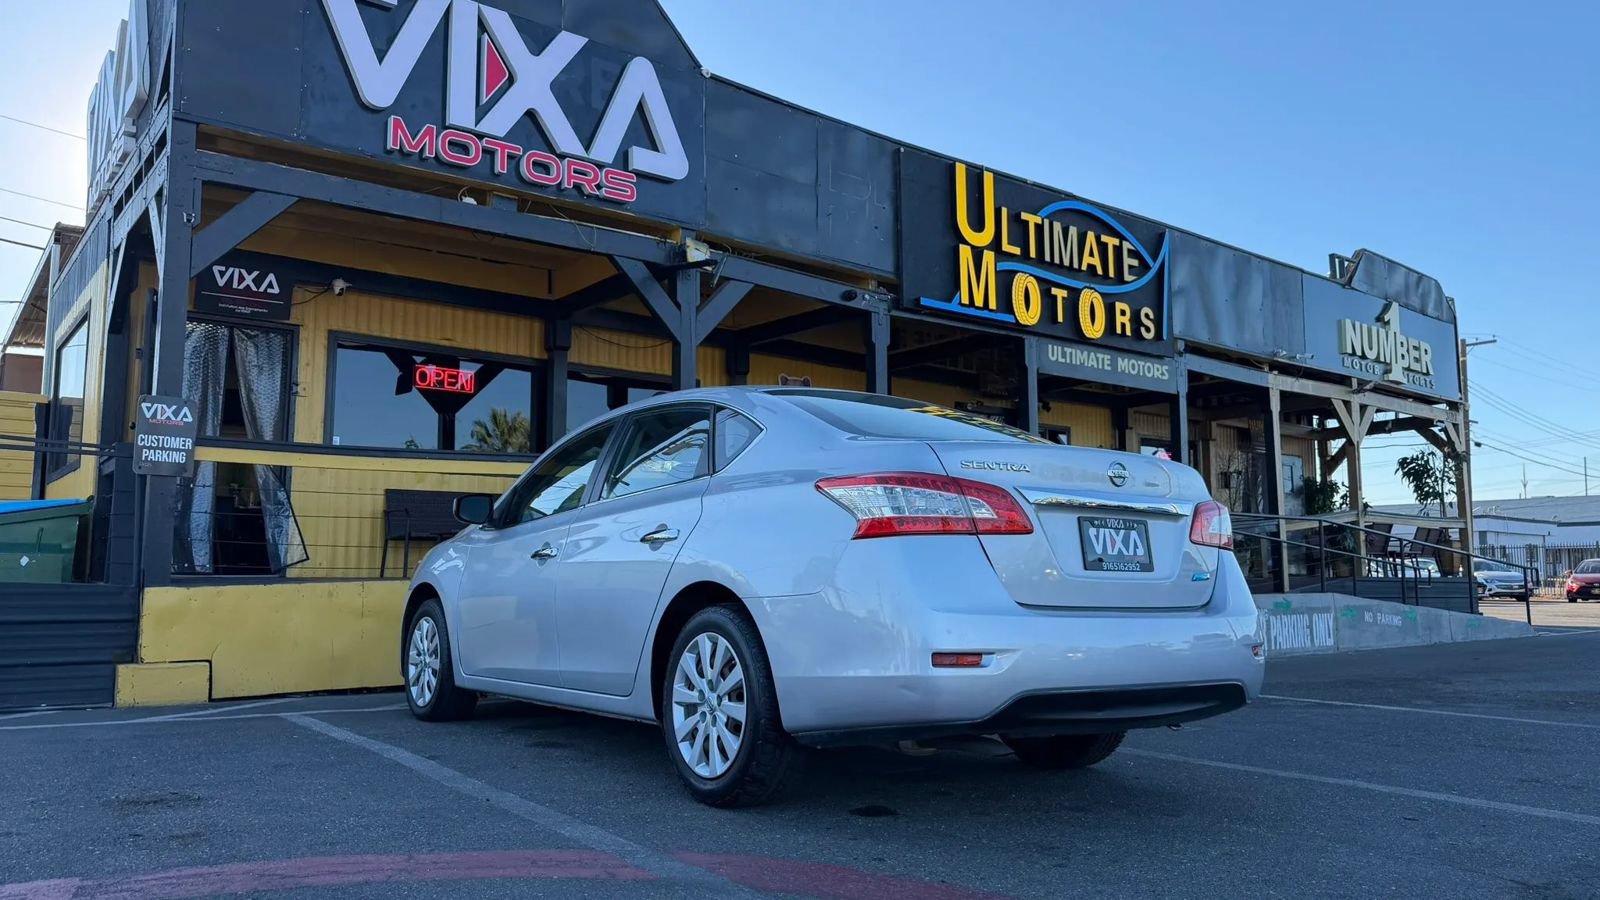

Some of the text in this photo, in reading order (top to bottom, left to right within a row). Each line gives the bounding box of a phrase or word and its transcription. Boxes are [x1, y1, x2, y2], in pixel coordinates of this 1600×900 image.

[322, 0, 690, 181] VIXA
[387, 115, 637, 203] MOTORS
[212, 264, 280, 294] VIXA
[1340, 318, 1434, 376] NUMBER
[1048, 344, 1169, 380] ULTIMATE MOTORS
[415, 367, 473, 392] OPEN
[141, 402, 193, 423] VIXA
[137, 434, 192, 450] CUSTOMER
[142, 448, 186, 464] PARKING
[960, 459, 1031, 473] SENTRA
[1106, 518, 1125, 529] VIXA
[1088, 527, 1145, 556] VIXA
[1269, 613, 1311, 650] PARKING
[1312, 612, 1334, 648] ONLY
[1364, 610, 1402, 627] NO PARKING
